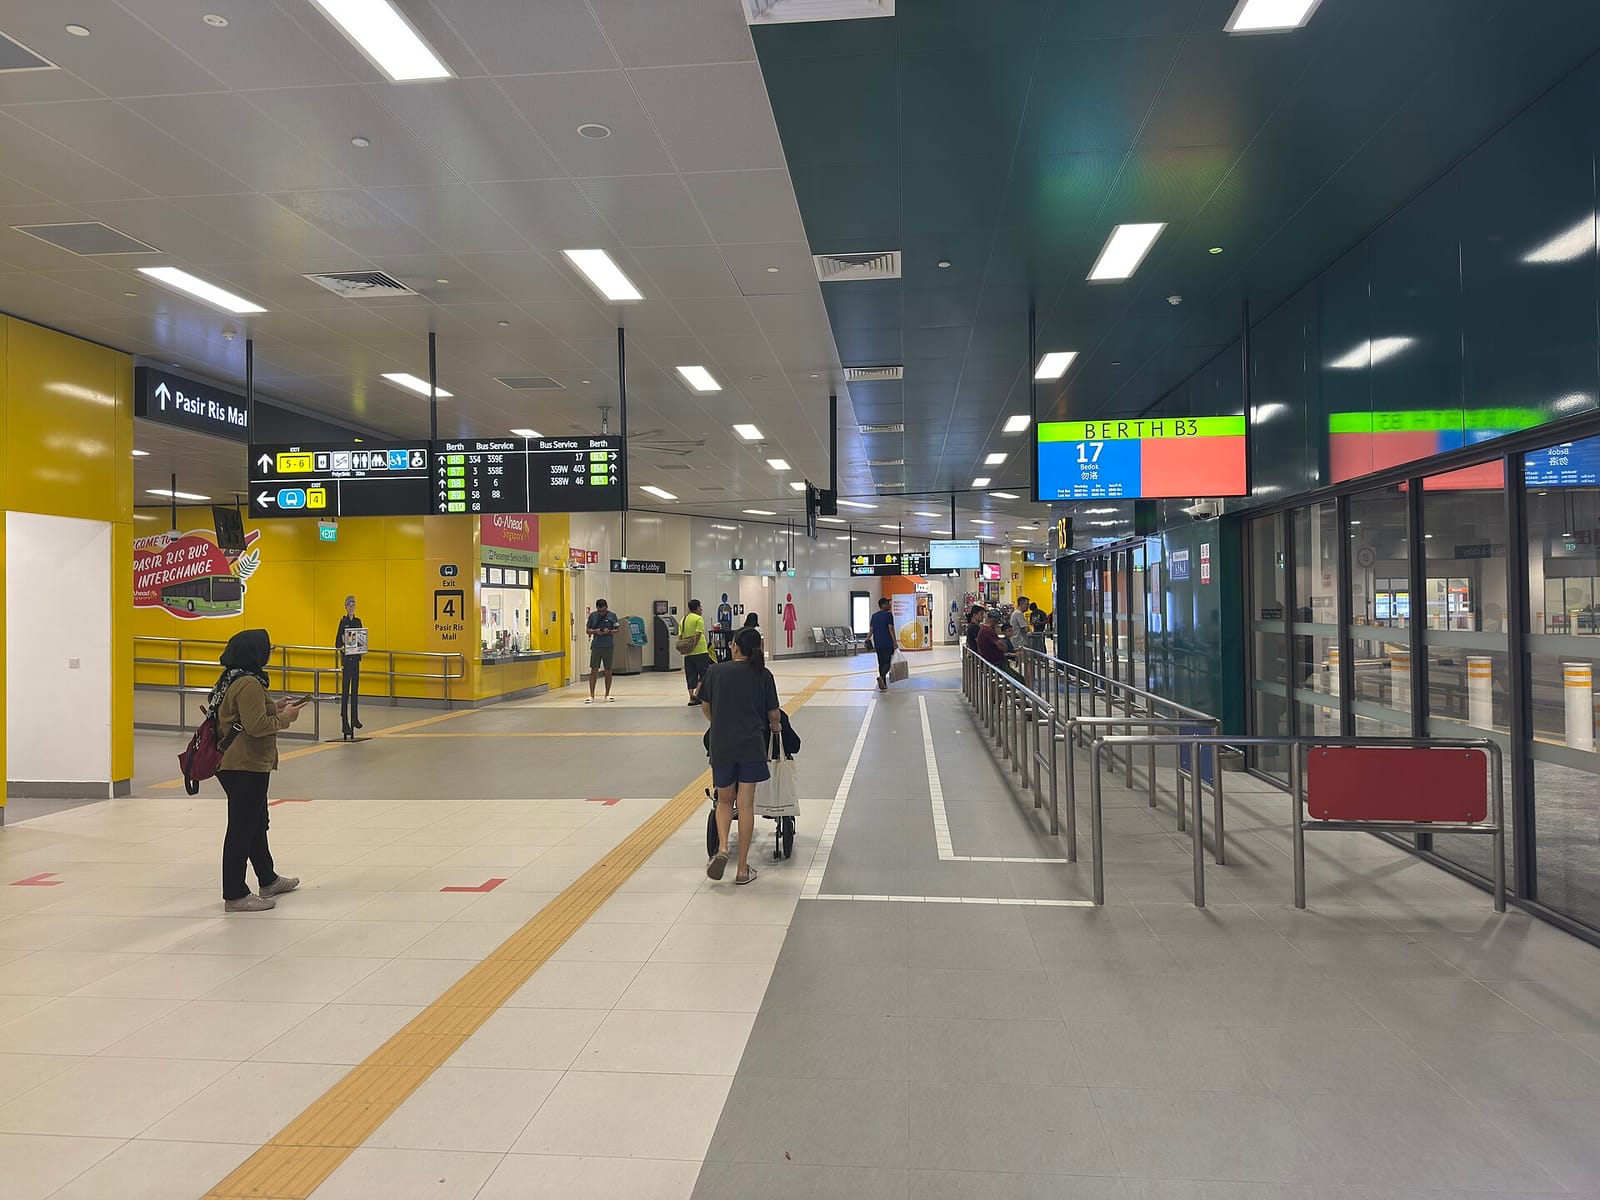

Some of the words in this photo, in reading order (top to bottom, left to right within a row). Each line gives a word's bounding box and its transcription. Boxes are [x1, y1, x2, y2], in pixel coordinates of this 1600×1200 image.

[176, 391, 206, 416] Pasir
[208, 401, 225, 421] Ris
[227, 406, 248, 427] Mal
[1085, 421, 1163, 439] BERTH
[1176, 420, 1198, 436] B3
[446, 443, 465, 451] Berth
[476, 442, 489, 450] Bus
[489, 442, 514, 450] Service
[540, 441, 552, 449] Bus
[553, 440, 578, 448] Service
[589, 440, 608, 448] Berth
[575, 453, 583, 461] 17
[1076, 442, 1104, 463] 17
[286, 460, 291, 468] 5
[469, 455, 481, 464] 354
[487, 455, 503, 463] 359E
[472, 467, 478, 475] 3
[550, 465, 569, 473] 359W
[573, 464, 585, 473] 403
[575, 477, 584, 485] 46
[1081, 472, 1098, 481] 勿洛
[473, 479, 479, 487] 5
[493, 479, 499, 487] 6
[471, 490, 481, 499] 58
[492, 490, 501, 499] 88
[313, 495, 319, 504] 4
[472, 502, 481, 511] 68
[493, 514, 524, 530] Go-Ahead
[325, 529, 336, 539] EXIT
[134, 535, 158, 550] COME
[134, 553, 163, 572] PASIR
[166, 549, 185, 565] RIS
[188, 543, 209, 560] BUS
[641, 563, 660, 573] e-Lobby
[138, 559, 213, 588] INTERCHANGE
[442, 600, 455, 617] 4
[442, 633, 457, 641] Mall
